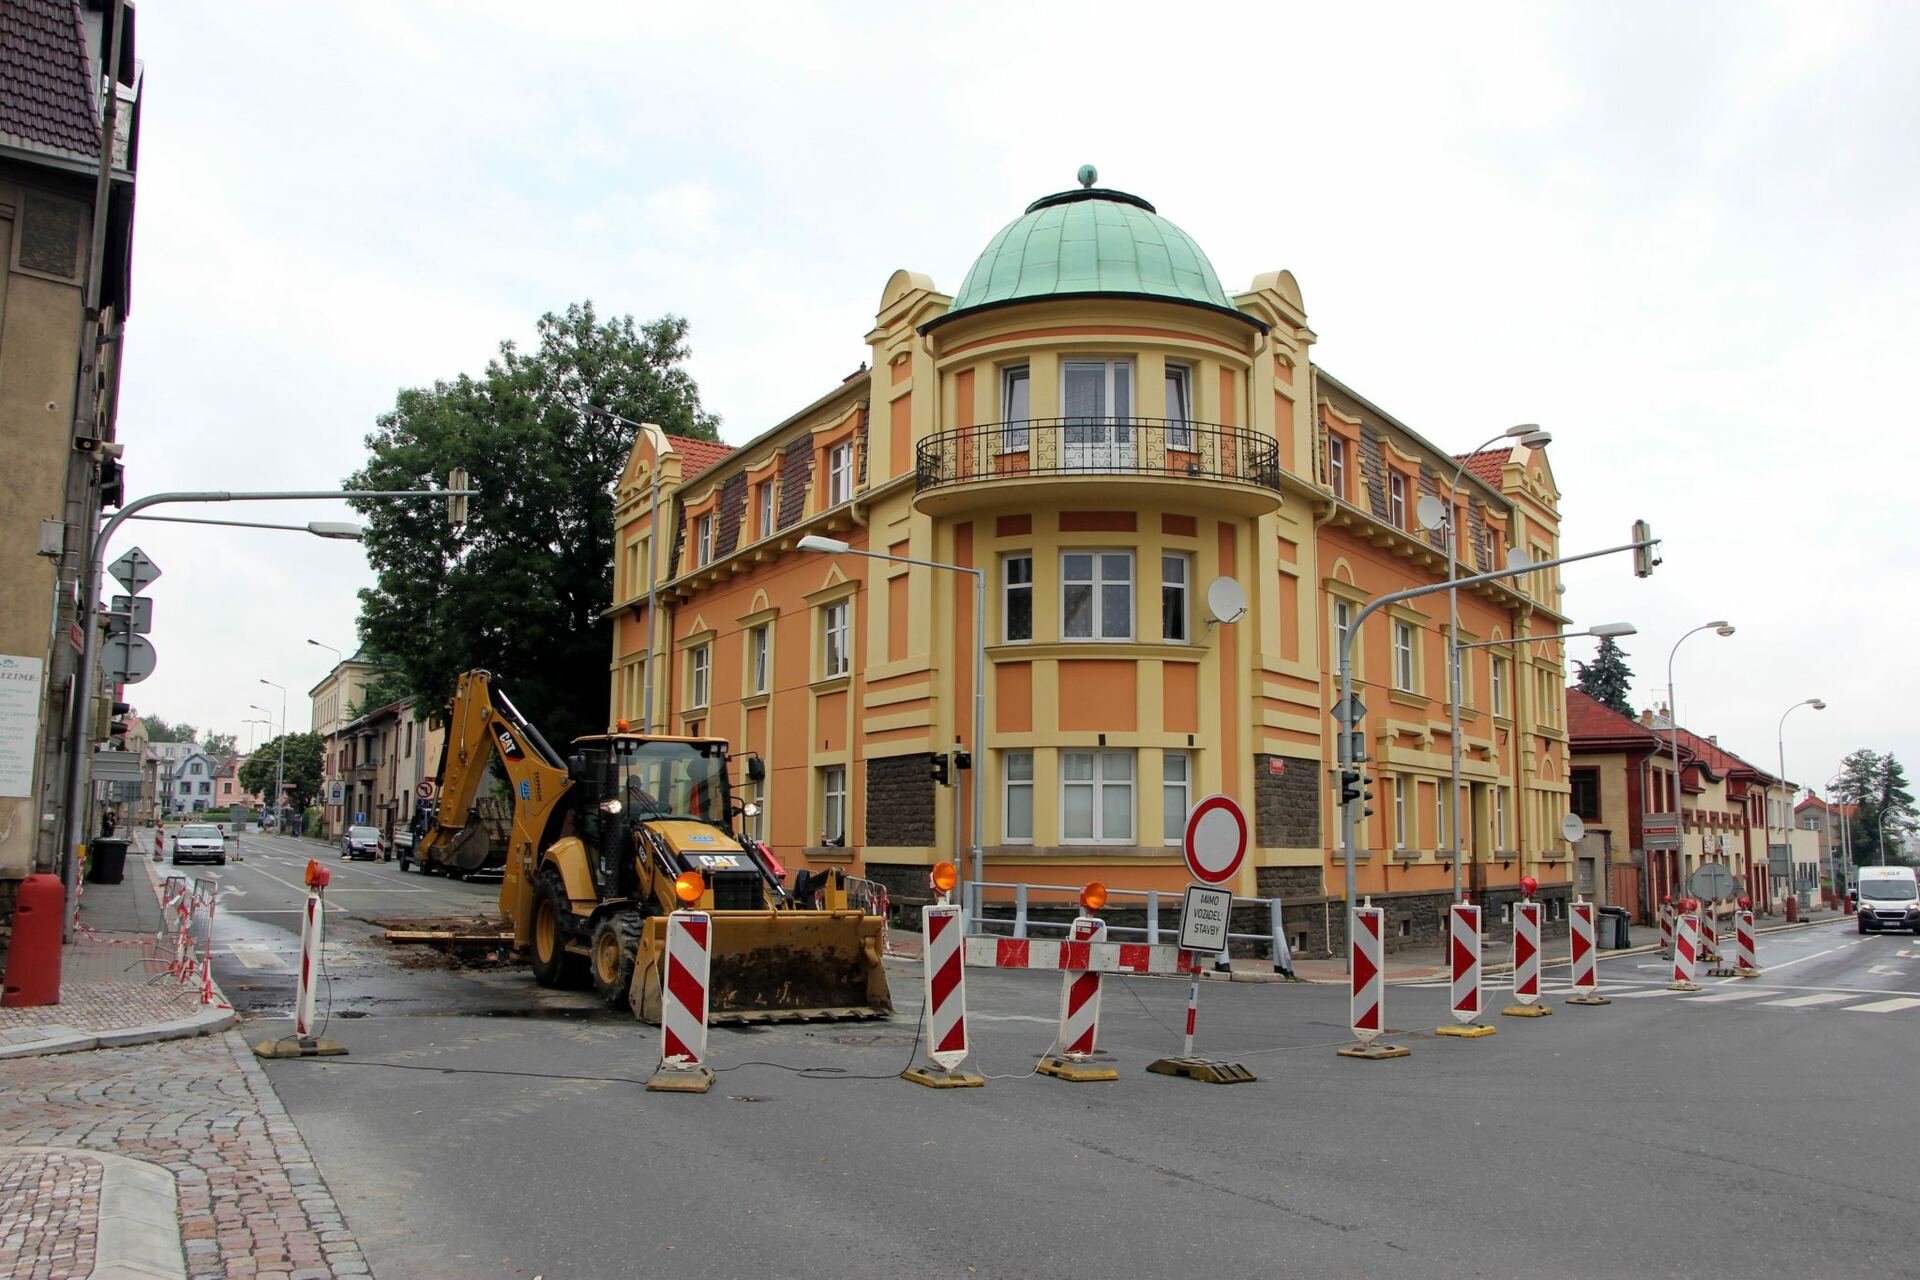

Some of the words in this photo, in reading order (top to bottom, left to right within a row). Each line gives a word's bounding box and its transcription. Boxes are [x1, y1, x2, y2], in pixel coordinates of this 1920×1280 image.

[499, 732, 516, 753] CAT
[699, 855, 740, 867] CAT
[1200, 894, 1219, 905] MIMO
[1193, 908, 1222, 921] VOZIDEL
[1193, 923, 1220, 935] STAVBY
